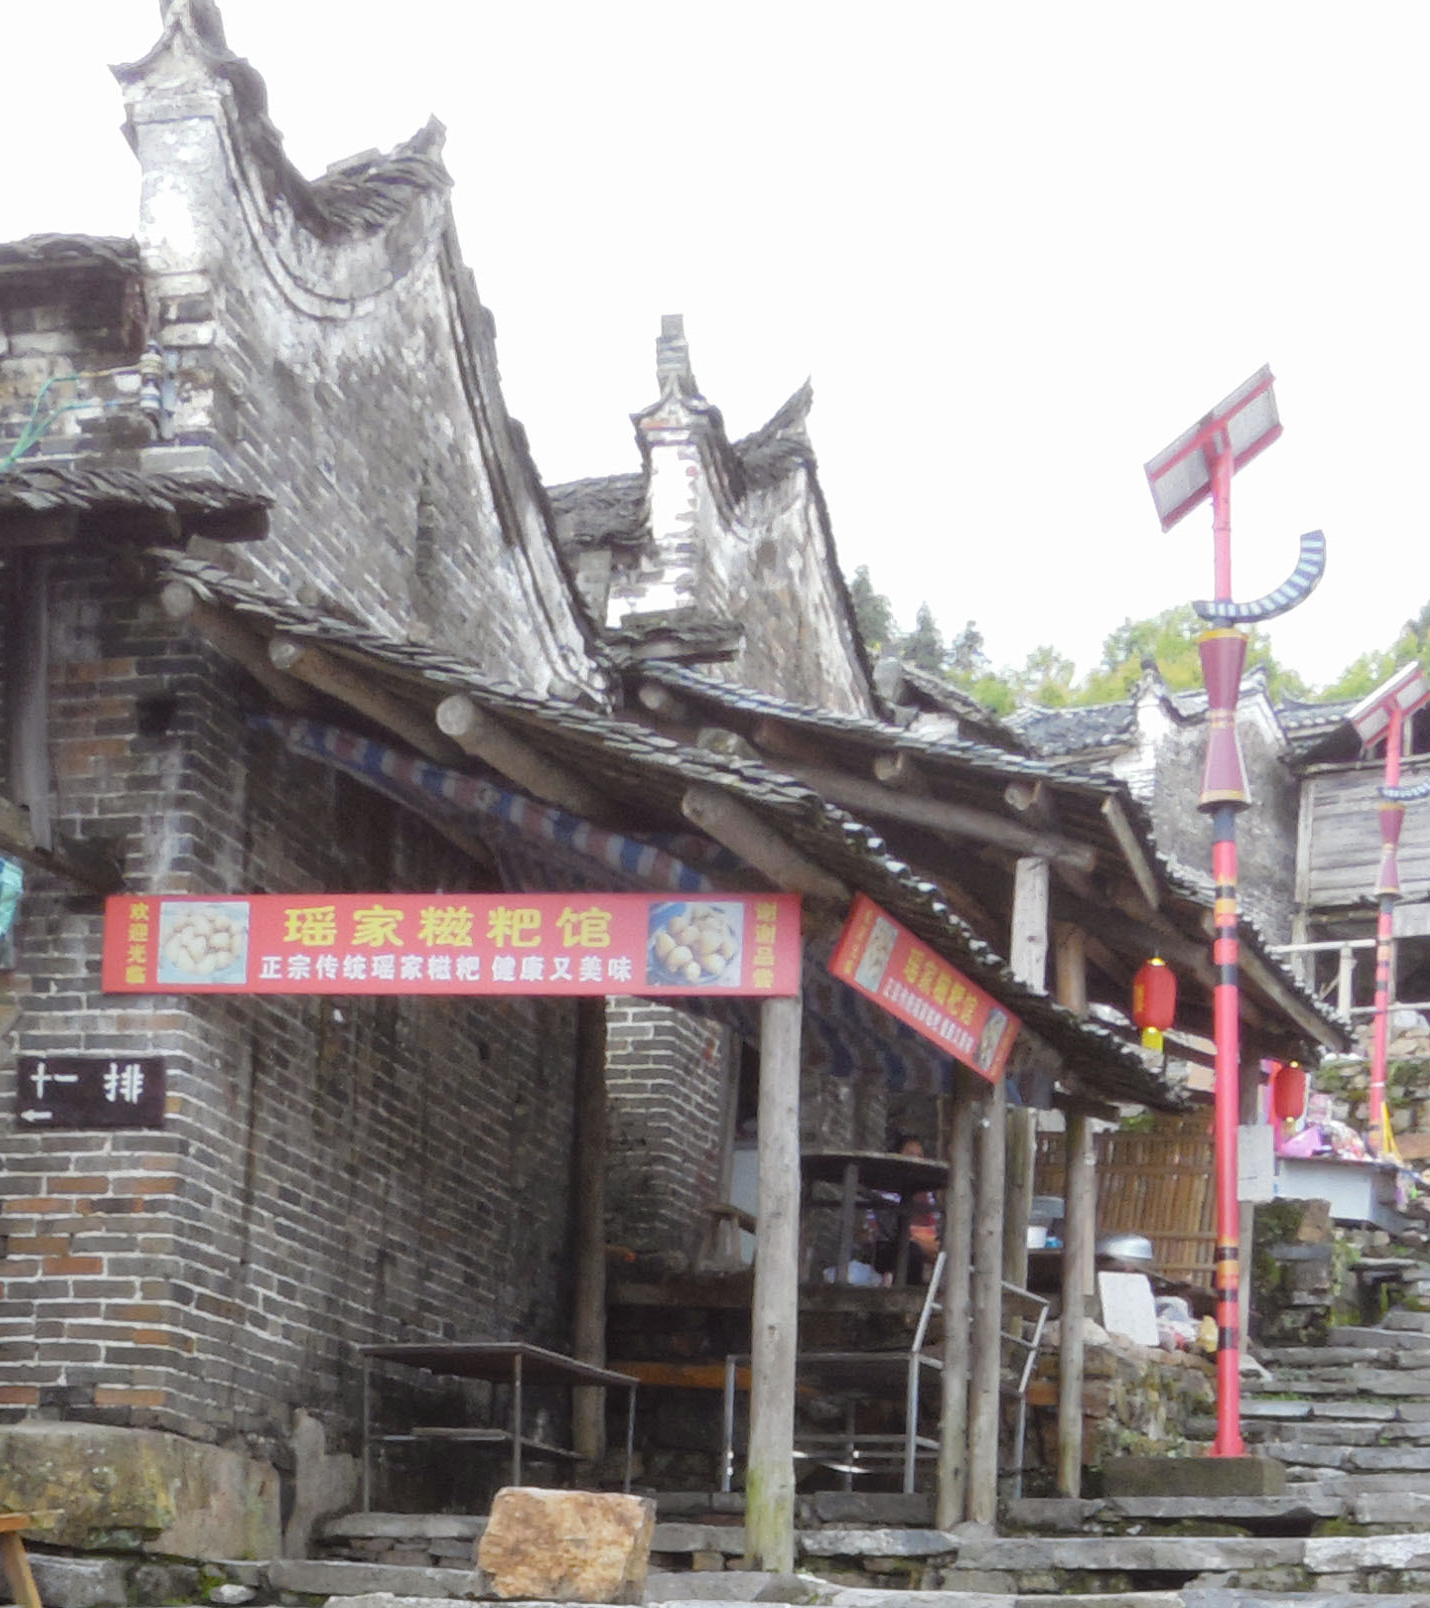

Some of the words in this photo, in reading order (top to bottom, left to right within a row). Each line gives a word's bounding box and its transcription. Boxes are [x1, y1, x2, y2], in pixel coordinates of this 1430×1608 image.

[283, 903, 613, 949] 瑶家糍粑馆
[491, 955, 634, 983] 健康又美味
[29, 1062, 79, 1100] 十一
[103, 1062, 145, 1104] 排
